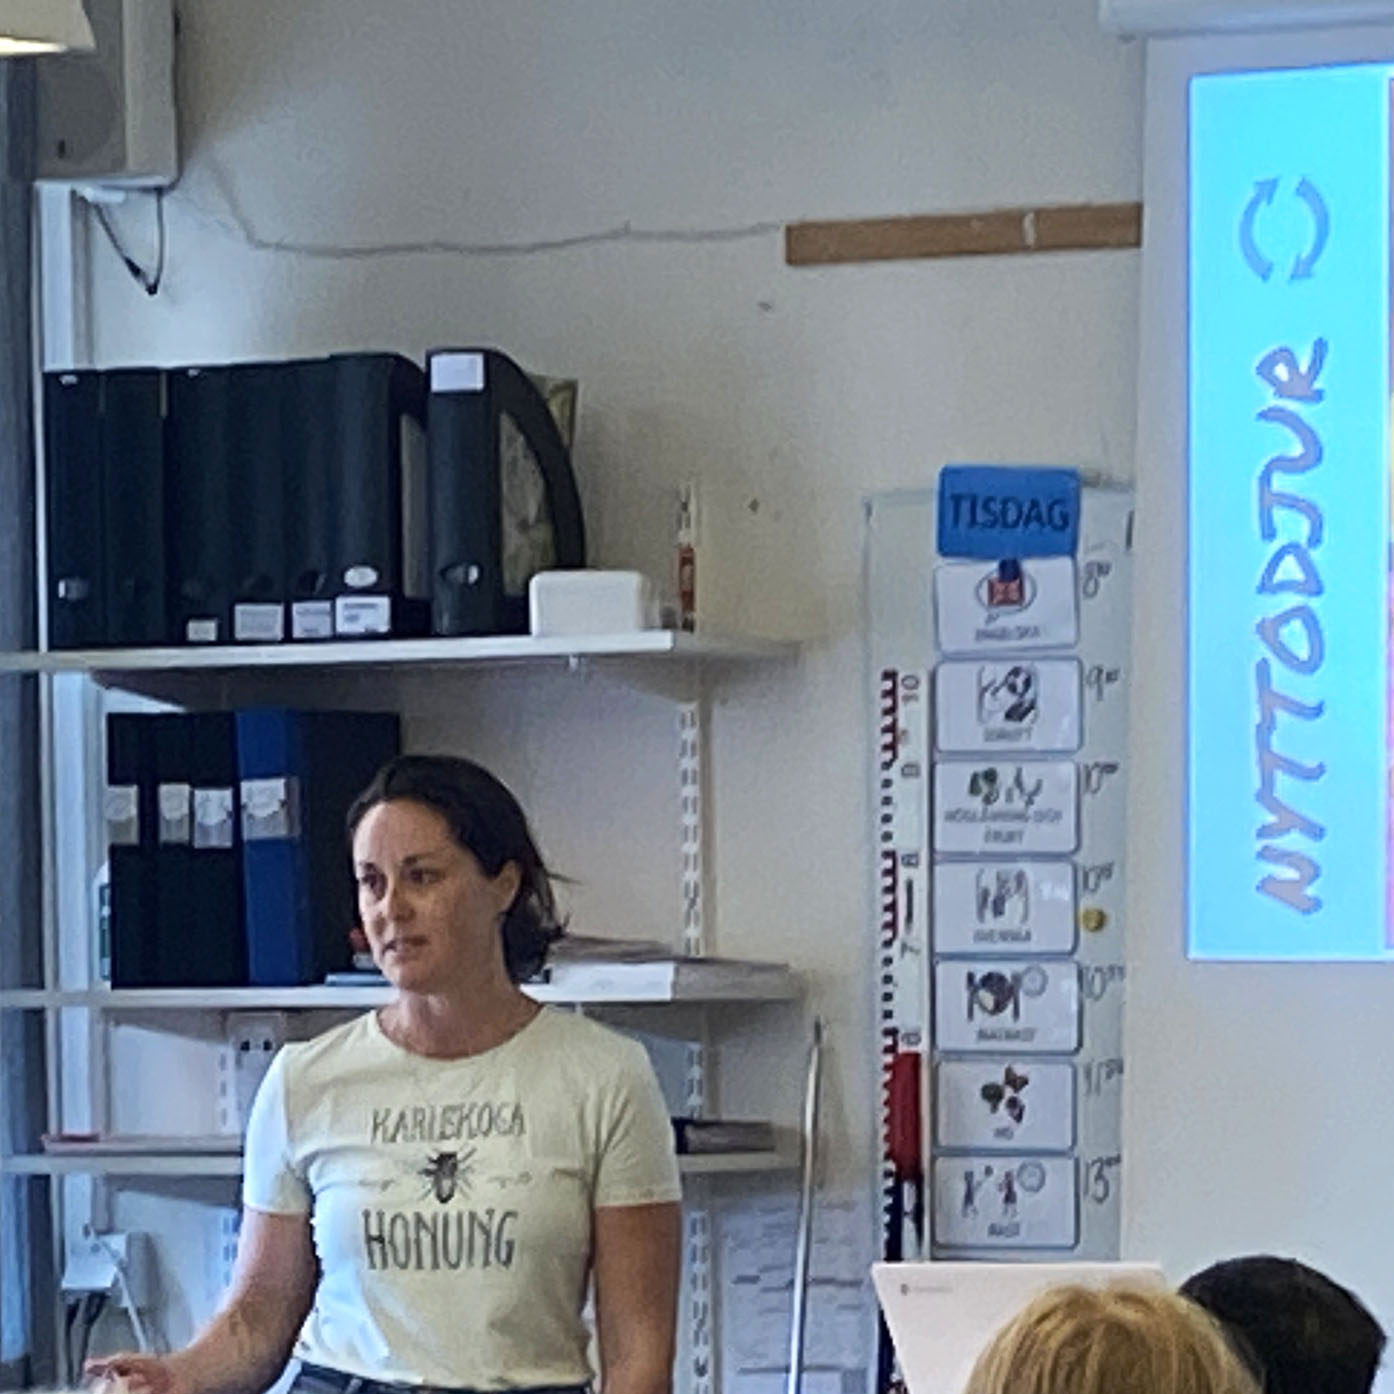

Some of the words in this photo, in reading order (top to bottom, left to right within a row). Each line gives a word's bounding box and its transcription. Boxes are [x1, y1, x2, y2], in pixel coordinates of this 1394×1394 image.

[950, 493, 1070, 532] TISDAG
[1255, 336, 1328, 916] NYTTODJUR
[362, 1208, 518, 1271] HONUNG
